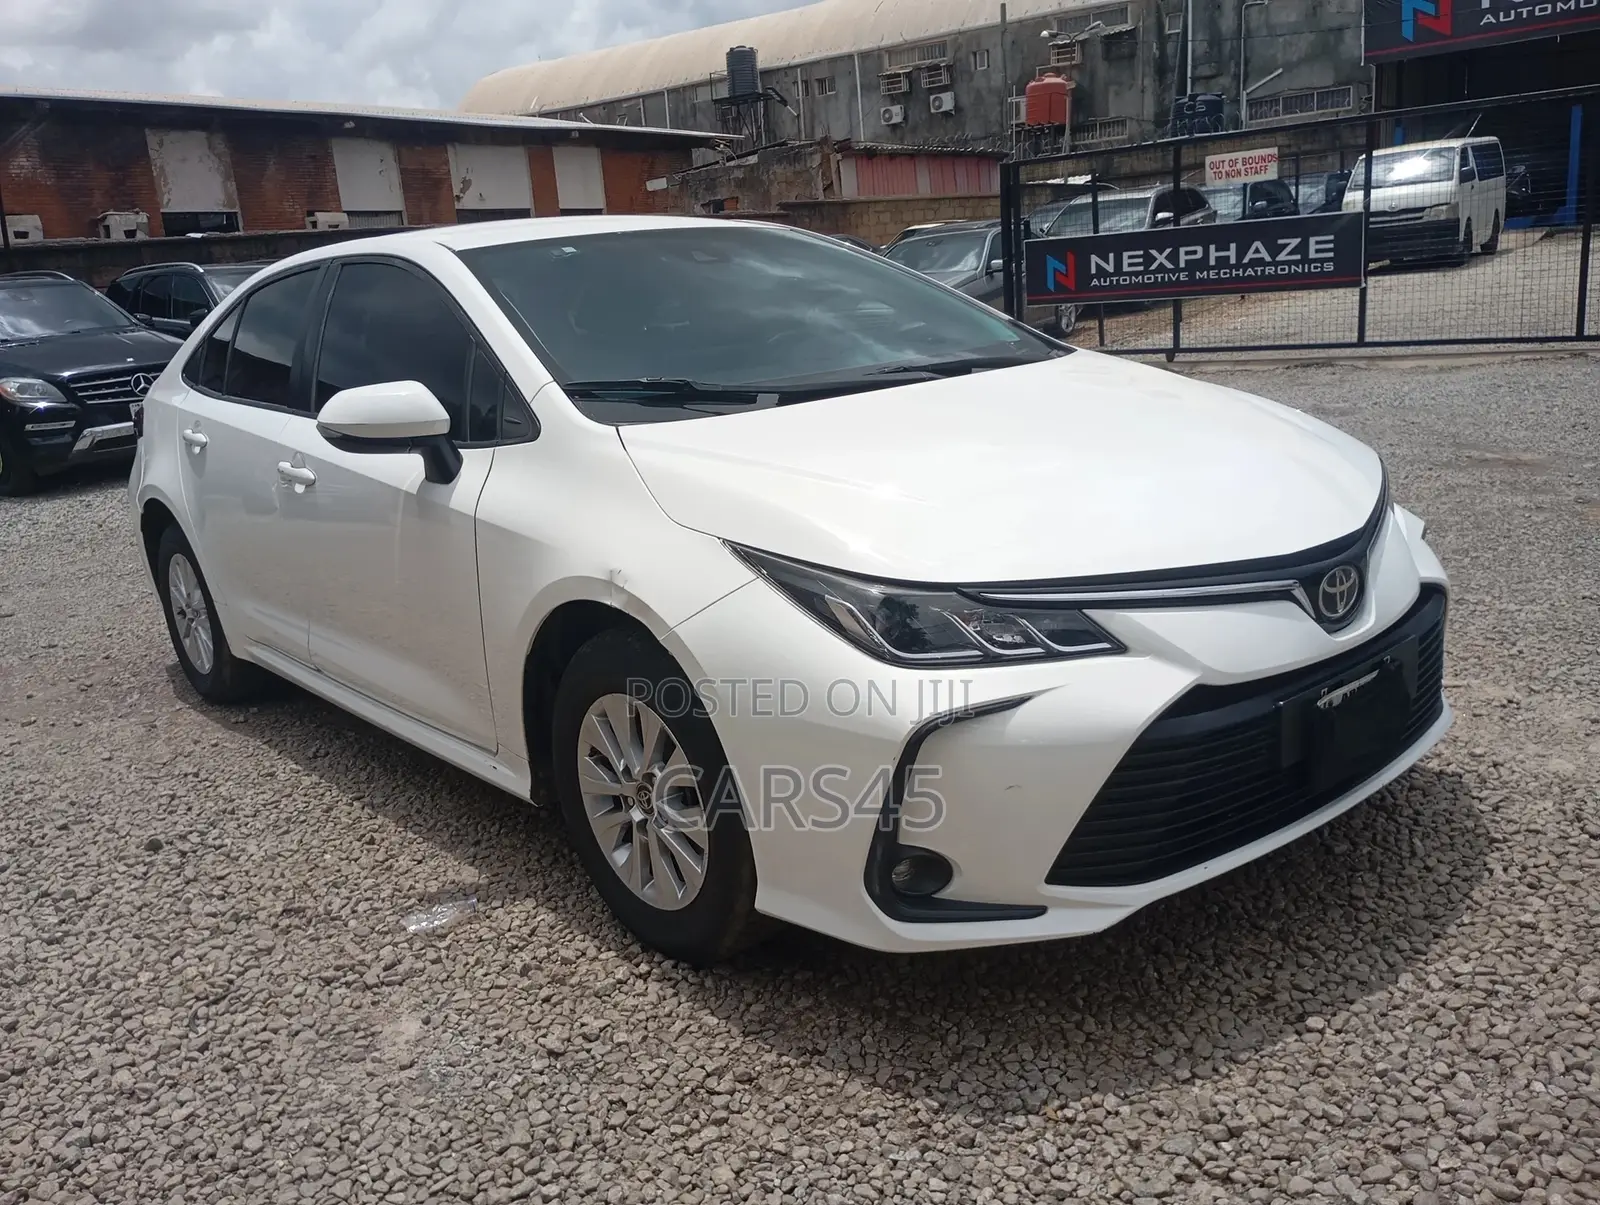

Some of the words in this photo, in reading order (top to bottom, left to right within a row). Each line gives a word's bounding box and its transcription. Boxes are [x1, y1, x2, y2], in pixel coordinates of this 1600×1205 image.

[1209, 160, 1226, 171] OUT
[1228, 158, 1240, 168] OF
[1241, 153, 1279, 167] BOUNDS
[1213, 170, 1223, 180] TO
[1225, 168, 1242, 179] NON
[1244, 165, 1269, 177] STAFF
[1090, 235, 1335, 275] NEXPHAZE
[1089, 271, 1189, 287] AUTOMOTIVE
[1196, 262, 1334, 279] MECHATRONICS
